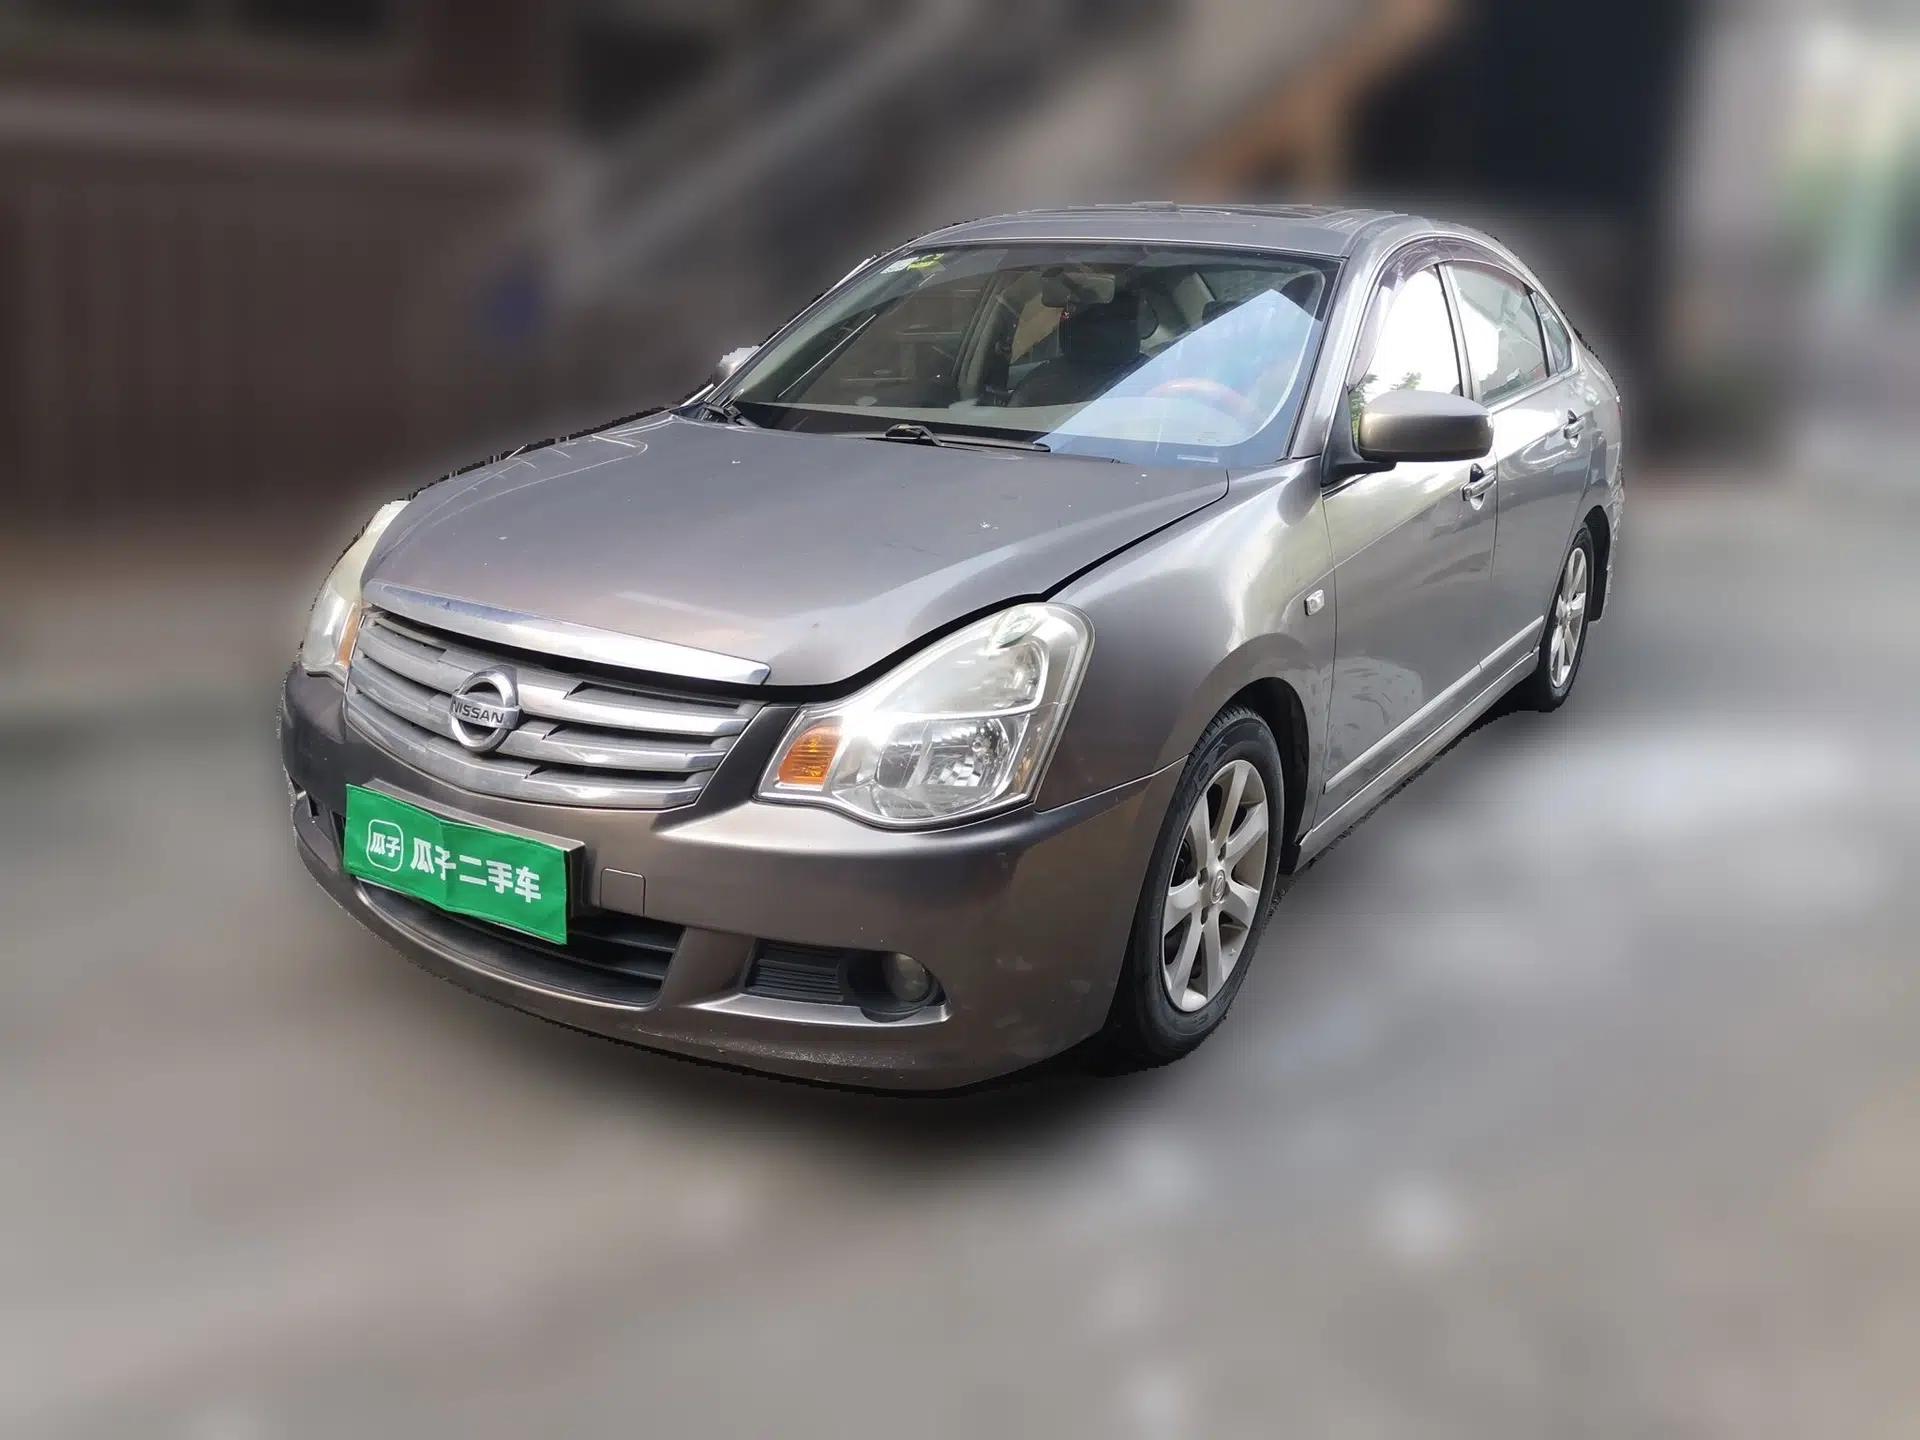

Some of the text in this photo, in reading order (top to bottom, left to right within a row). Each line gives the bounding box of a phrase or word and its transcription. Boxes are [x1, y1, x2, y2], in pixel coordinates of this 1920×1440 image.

[451, 700, 505, 724] NISSAN
[369, 832, 401, 858] 瓜子
[410, 837, 542, 903] 瓜子二手车
